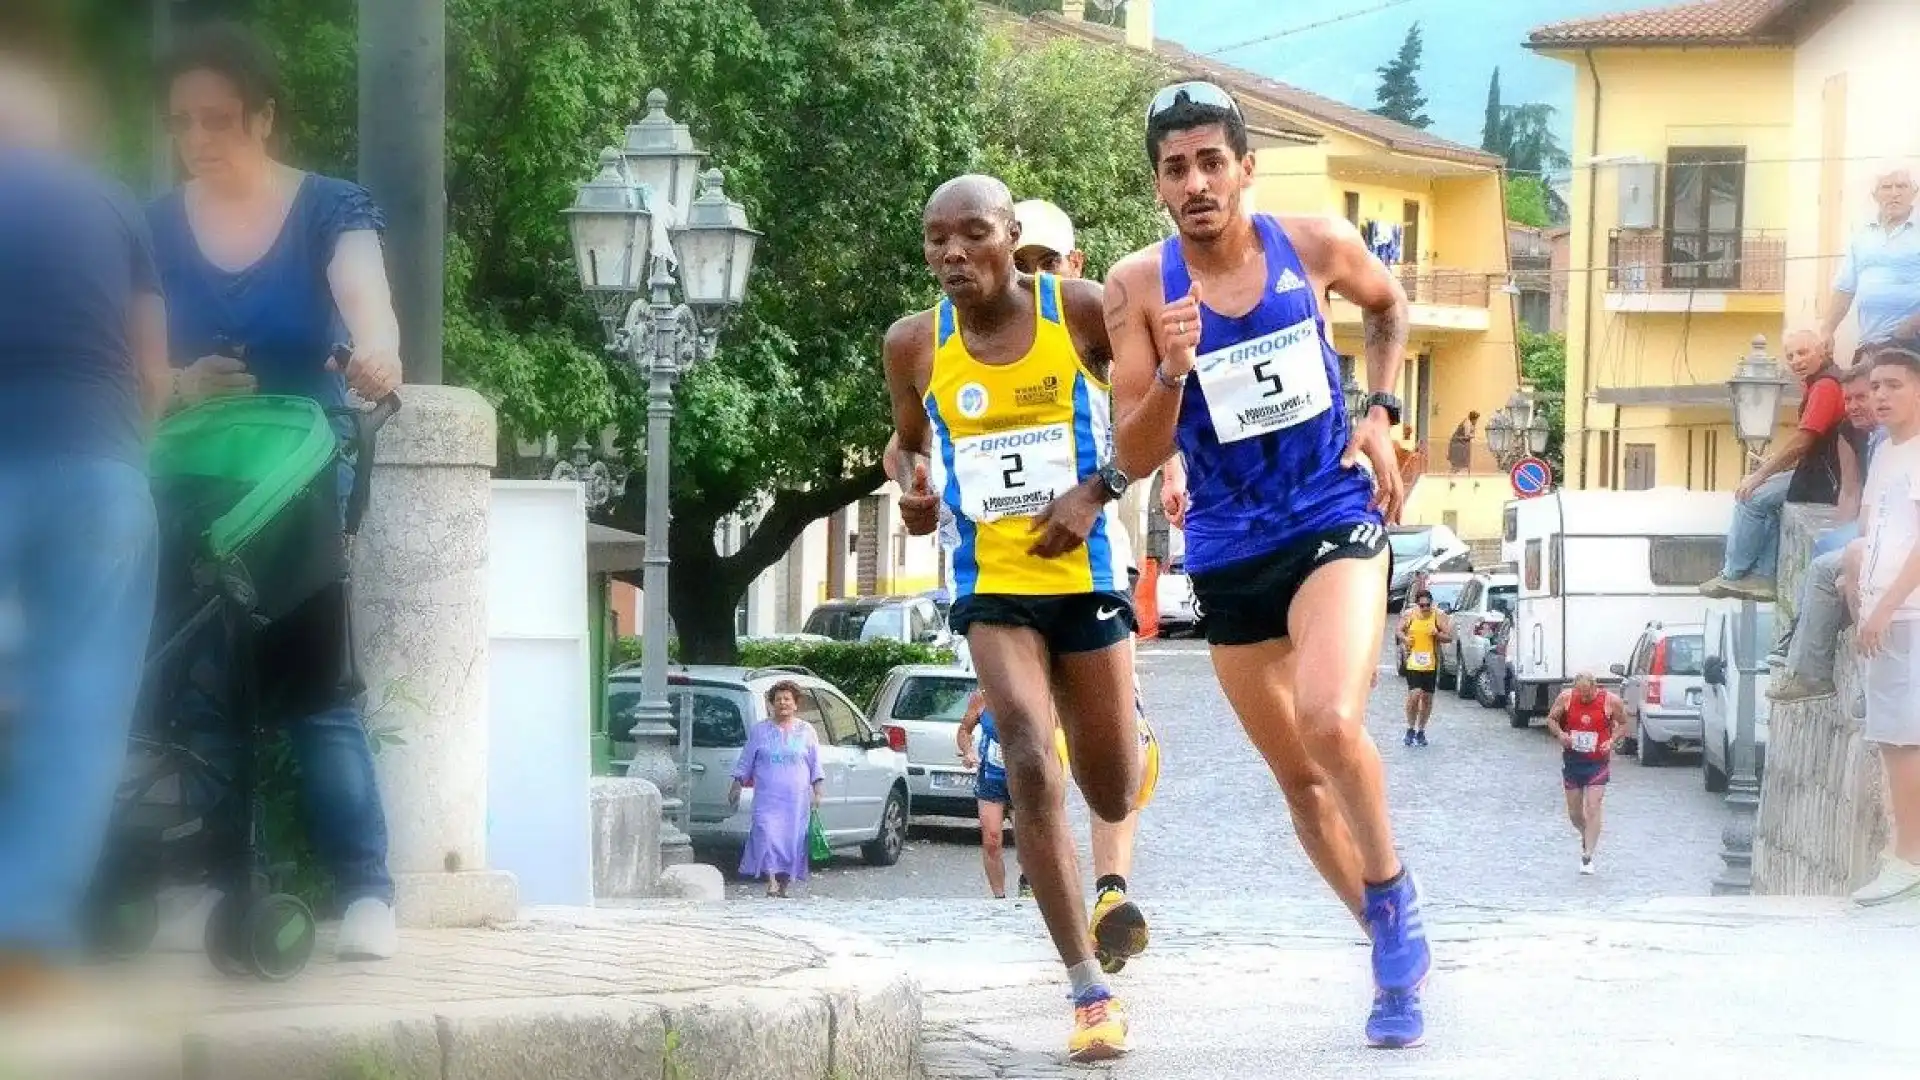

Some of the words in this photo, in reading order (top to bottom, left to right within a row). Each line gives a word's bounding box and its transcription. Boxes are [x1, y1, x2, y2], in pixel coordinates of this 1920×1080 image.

[1229, 325, 1312, 364] BROOKS
[1253, 359, 1283, 398] 5
[981, 427, 1064, 451] BROOKS
[1000, 453, 1026, 489] 2
